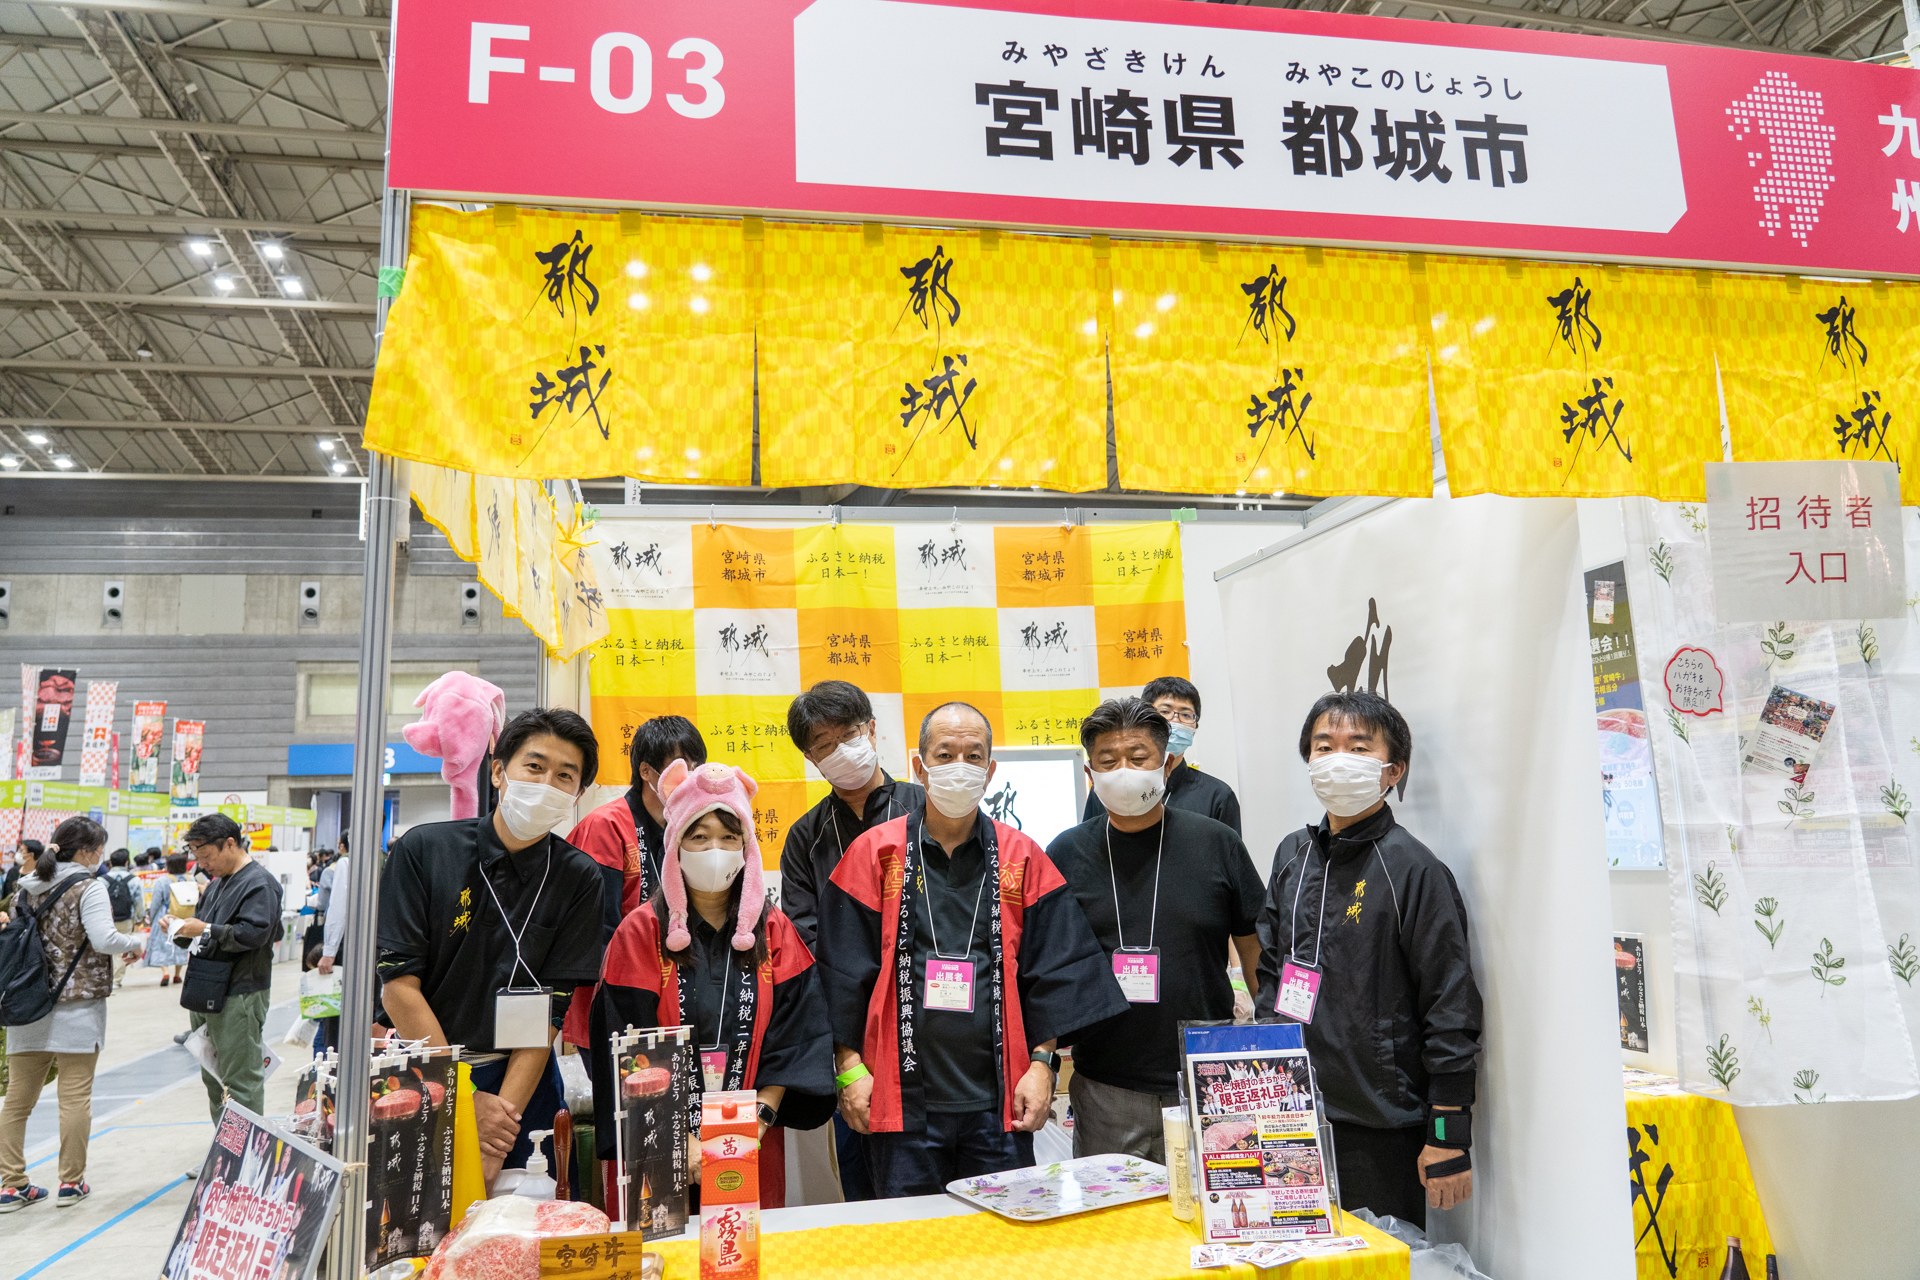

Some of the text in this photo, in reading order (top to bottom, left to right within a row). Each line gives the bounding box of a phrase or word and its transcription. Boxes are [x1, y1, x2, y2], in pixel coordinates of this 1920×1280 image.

[468, 22, 726, 119] F-03
[1002, 40, 1523, 100] みやざきけん みやこのじょうし
[975, 80, 1529, 188] 宮崎県 都城市
[1746, 495, 1872, 531] 招待者
[721, 549, 766, 566] 宮崎県
[806, 552, 886, 565] ふるさと納税
[1021, 550, 1065, 566] 宮崎県
[1102, 548, 1174, 562] ふるさと納税
[721, 567, 767, 582] 都城市
[821, 567, 868, 580] 日本一！
[1021, 567, 1065, 582] 都城市
[1117, 564, 1162, 577] 日本一！
[1785, 552, 1848, 584] 入口
[826, 632, 871, 649] 宮崎県
[909, 635, 990, 649] ふるさと納税
[1122, 627, 1163, 643] 宮崎県
[600, 638, 684, 651] ふるさと納税
[1123, 644, 1164, 660] 都城市
[615, 654, 666, 667] 日本一！
[826, 650, 872, 667] 都城市
[924, 651, 972, 664] 日本一！
[1678, 658, 1703, 669] こちらの
[1674, 671, 1704, 683] ハガキを
[1676, 684, 1712, 699] お持ちの方
[726, 741, 775, 753] 日本一！
[671, 1052, 681, 1101] ありがとう
[1212, 1073, 1287, 1094] 肉と焼酎のまちから
[445, 1067, 456, 1116] ありがとう
[1219, 1084, 1287, 1107] 限定返礼品
[422, 1083, 430, 1123] りがとう
[671, 1110, 682, 1170] ふるさと納税
[722, 1137, 738, 1156] 茜
[413, 1133, 428, 1192] ふるさと納税
[441, 1126, 454, 1186] ふるさと納税
[202, 1177, 297, 1234] 肉と焼酎のまちから
[717, 1207, 742, 1267] 霧島
[556, 1236, 626, 1269] 宮崎牛
